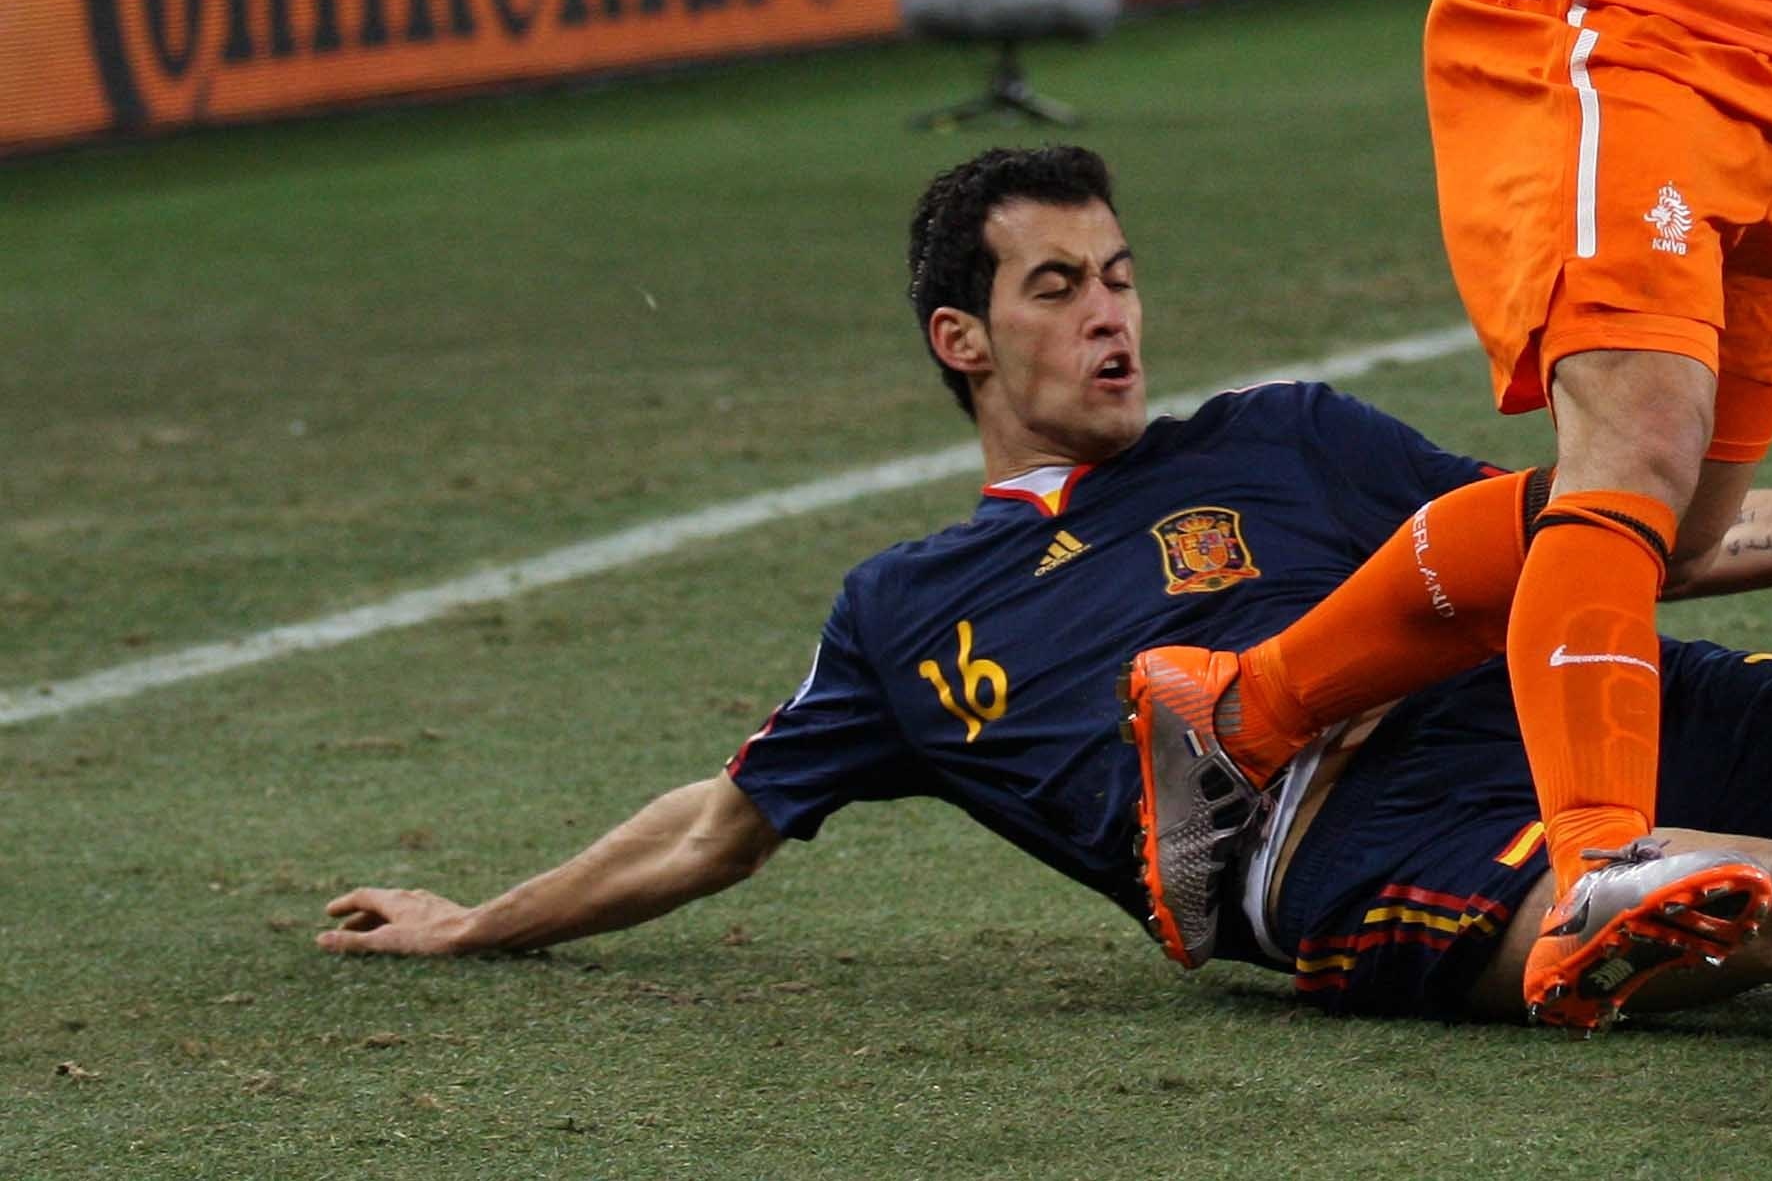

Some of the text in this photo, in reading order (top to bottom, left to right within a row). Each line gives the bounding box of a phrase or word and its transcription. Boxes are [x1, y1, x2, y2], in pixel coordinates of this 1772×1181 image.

[1652, 238, 1687, 255] KNVB
[1412, 501, 1456, 618] ERLAND
[918, 619, 1008, 743] 16
